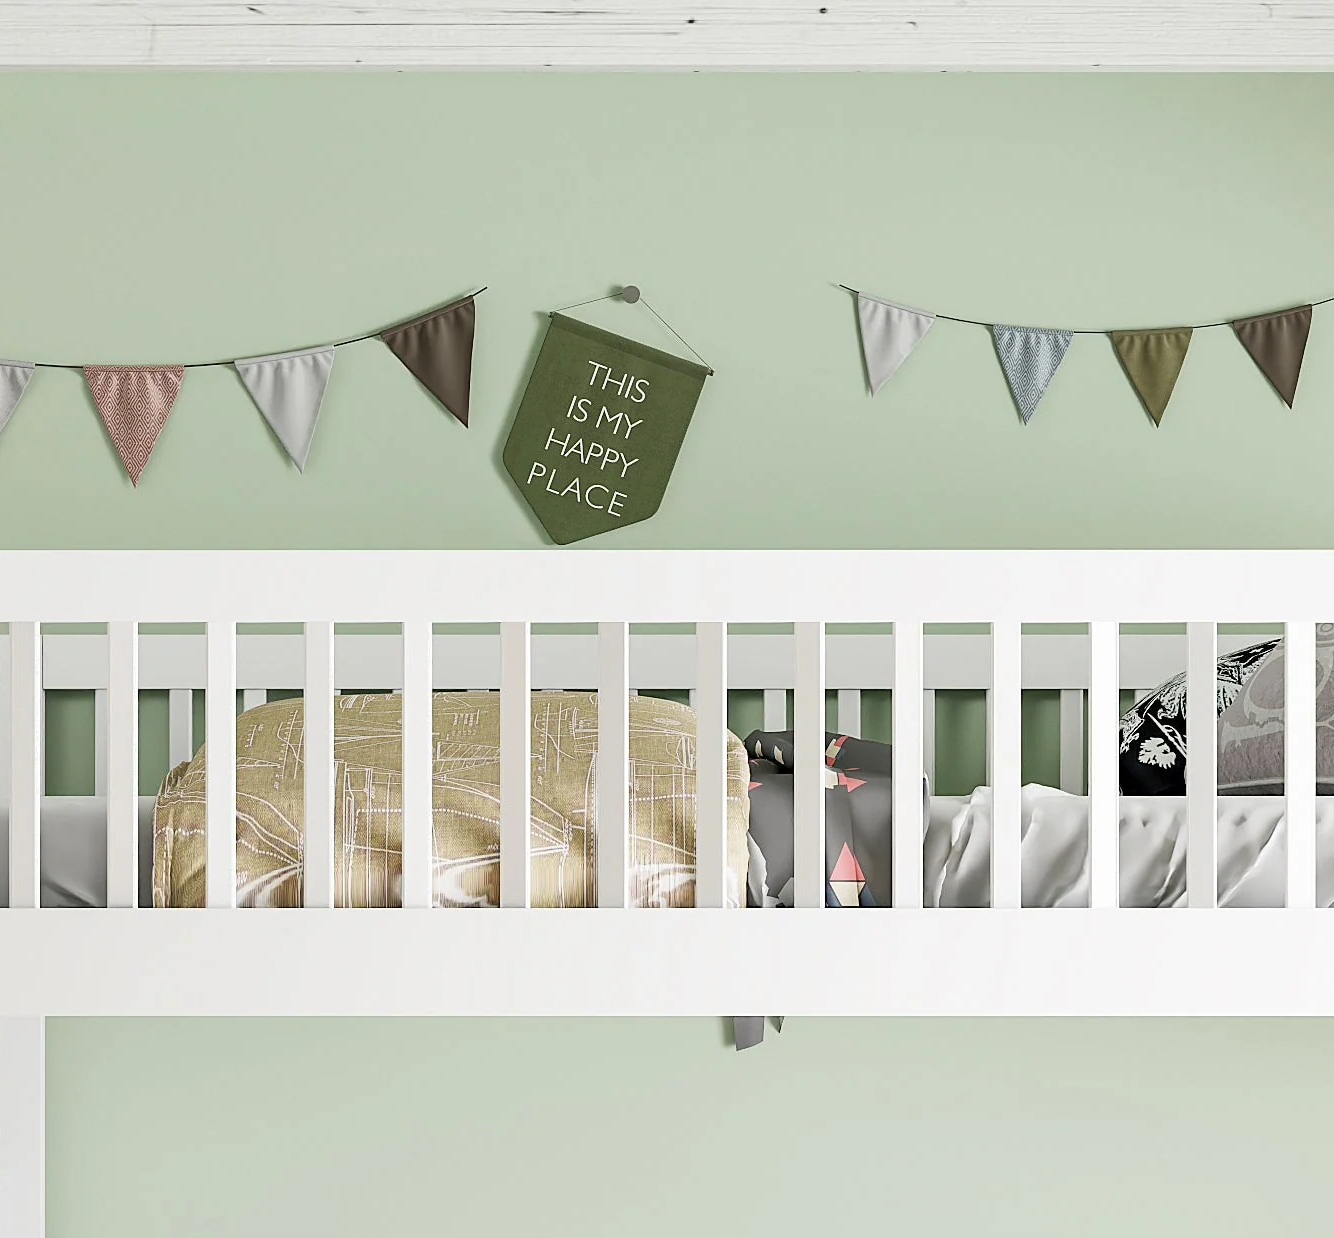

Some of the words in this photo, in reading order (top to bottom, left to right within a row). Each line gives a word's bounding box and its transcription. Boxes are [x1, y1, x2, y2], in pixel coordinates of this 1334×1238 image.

[588, 360, 650, 403] THIS
[566, 395, 592, 423] IS
[595, 405, 643, 440] MY
[544, 427, 639, 478] HAPPY
[526, 461, 628, 518] PLACE
